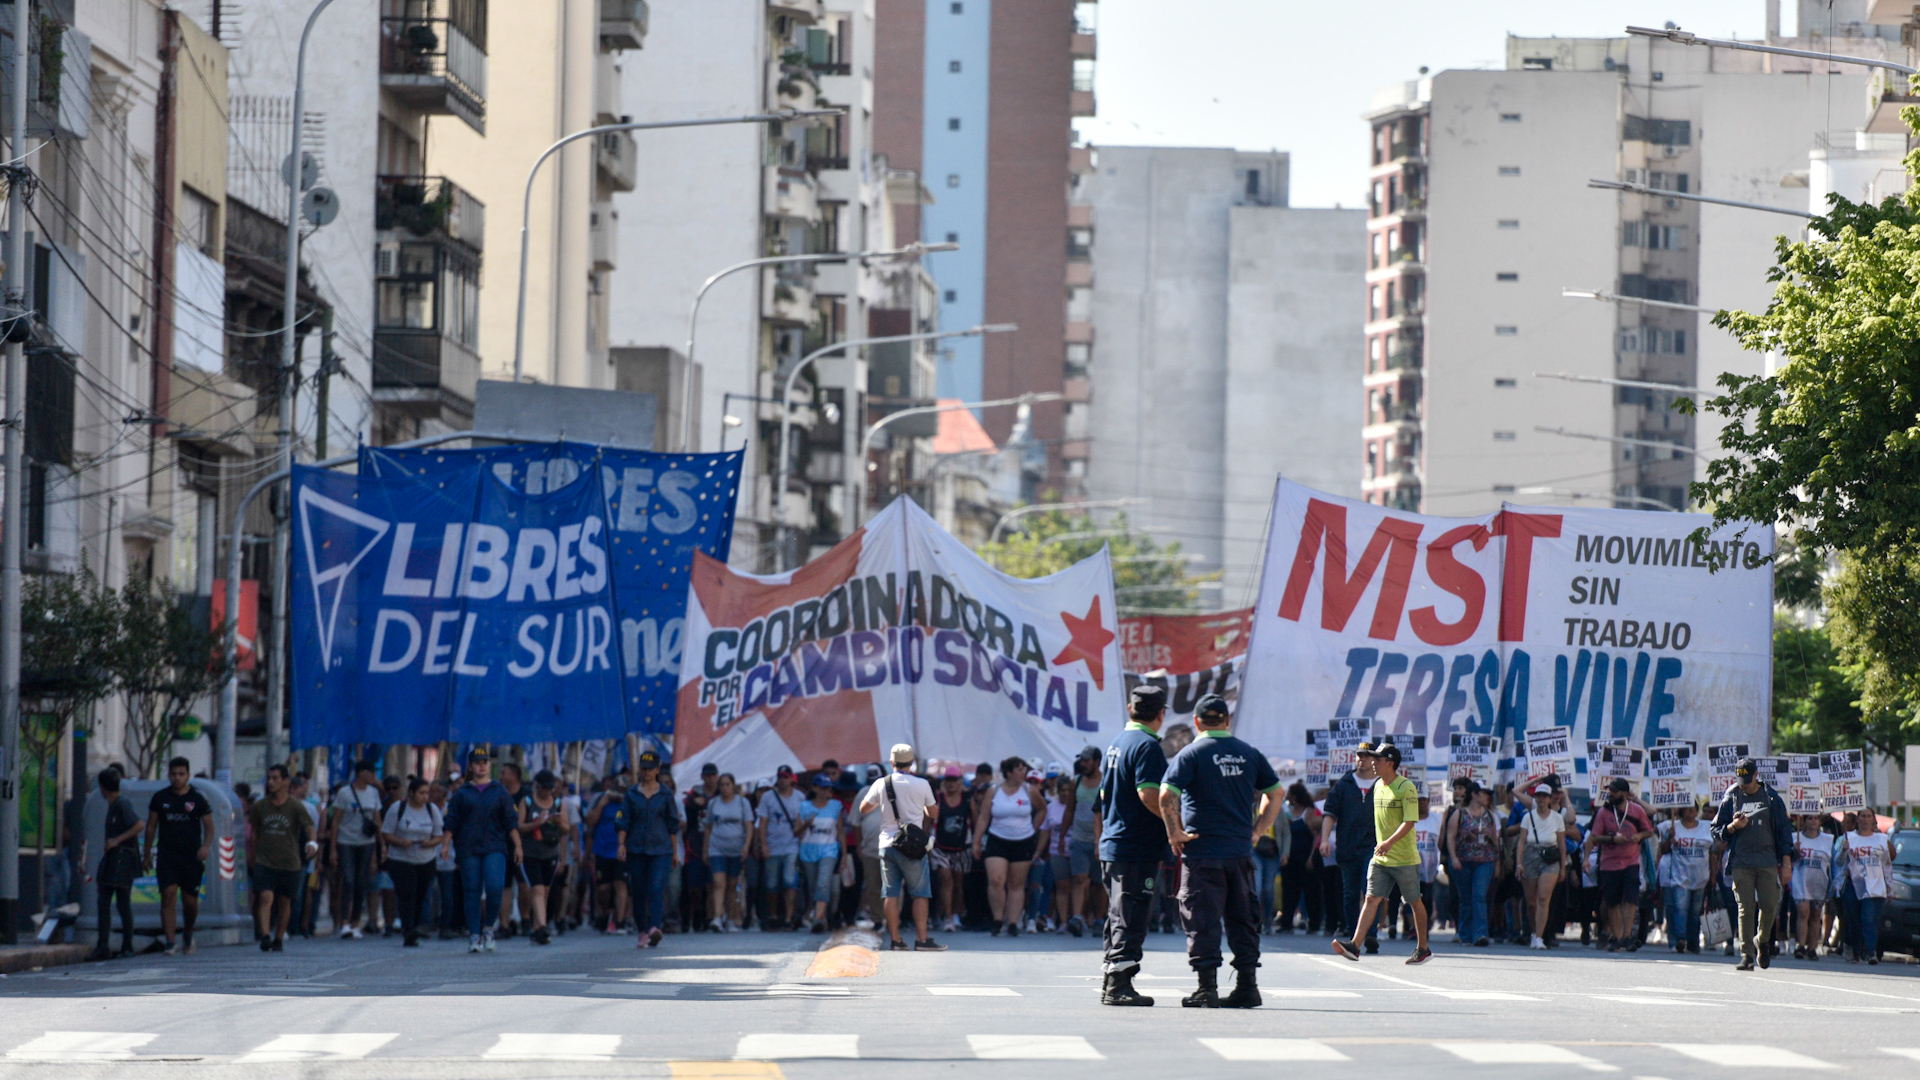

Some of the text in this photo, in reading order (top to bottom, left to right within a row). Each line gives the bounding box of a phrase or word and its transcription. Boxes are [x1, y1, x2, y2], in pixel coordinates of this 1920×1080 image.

[383, 516, 608, 601] LIBRES
[1575, 535, 1760, 570] MOVIMIENTO
[1278, 498, 1563, 646] MST
[1569, 576, 1620, 605] SIN
[704, 569, 1047, 679] COORDINADORA
[367, 605, 612, 678] DEL SUR
[1564, 618, 1691, 650] TRABAJO
[742, 626, 924, 714] CAMBIO
[934, 629, 1100, 733] SOCIAL
[701, 675, 742, 706] POR
[1334, 648, 1530, 748] TERESA
[1554, 648, 1682, 748] VIVE
[716, 702, 738, 729] EL
[1460, 735, 1480, 746] CESE
[1530, 738, 1569, 757] Fuera el FMI
[1330, 749, 1354, 763] MST
[1659, 749, 1679, 761] CESE
[1718, 746, 1738, 758] CESE
[1829, 752, 1850, 765] CESE
[1306, 758, 1328, 773] MST
[1451, 763, 1473, 778] MST
[1531, 760, 1555, 776] MST
[1657, 767, 1683, 776] DESPIDOS
[1822, 761, 1861, 774] DE LOS 160 MIL
[1710, 776, 1733, 791] MST
[1828, 771, 1856, 781] DESPIDOS
[1652, 779, 1675, 794] MST
[1790, 786, 1804, 800] ST
[1823, 781, 1847, 797] MST
[1653, 792, 1691, 805] TERESA VIVE
[1804, 800, 1818, 810] VIVE
[1824, 795, 1863, 808] TERESA VIVE
[1741, 802, 1762, 813] NIKE
[1416, 831, 1428, 842] ST
[1801, 848, 1814, 858] ST
